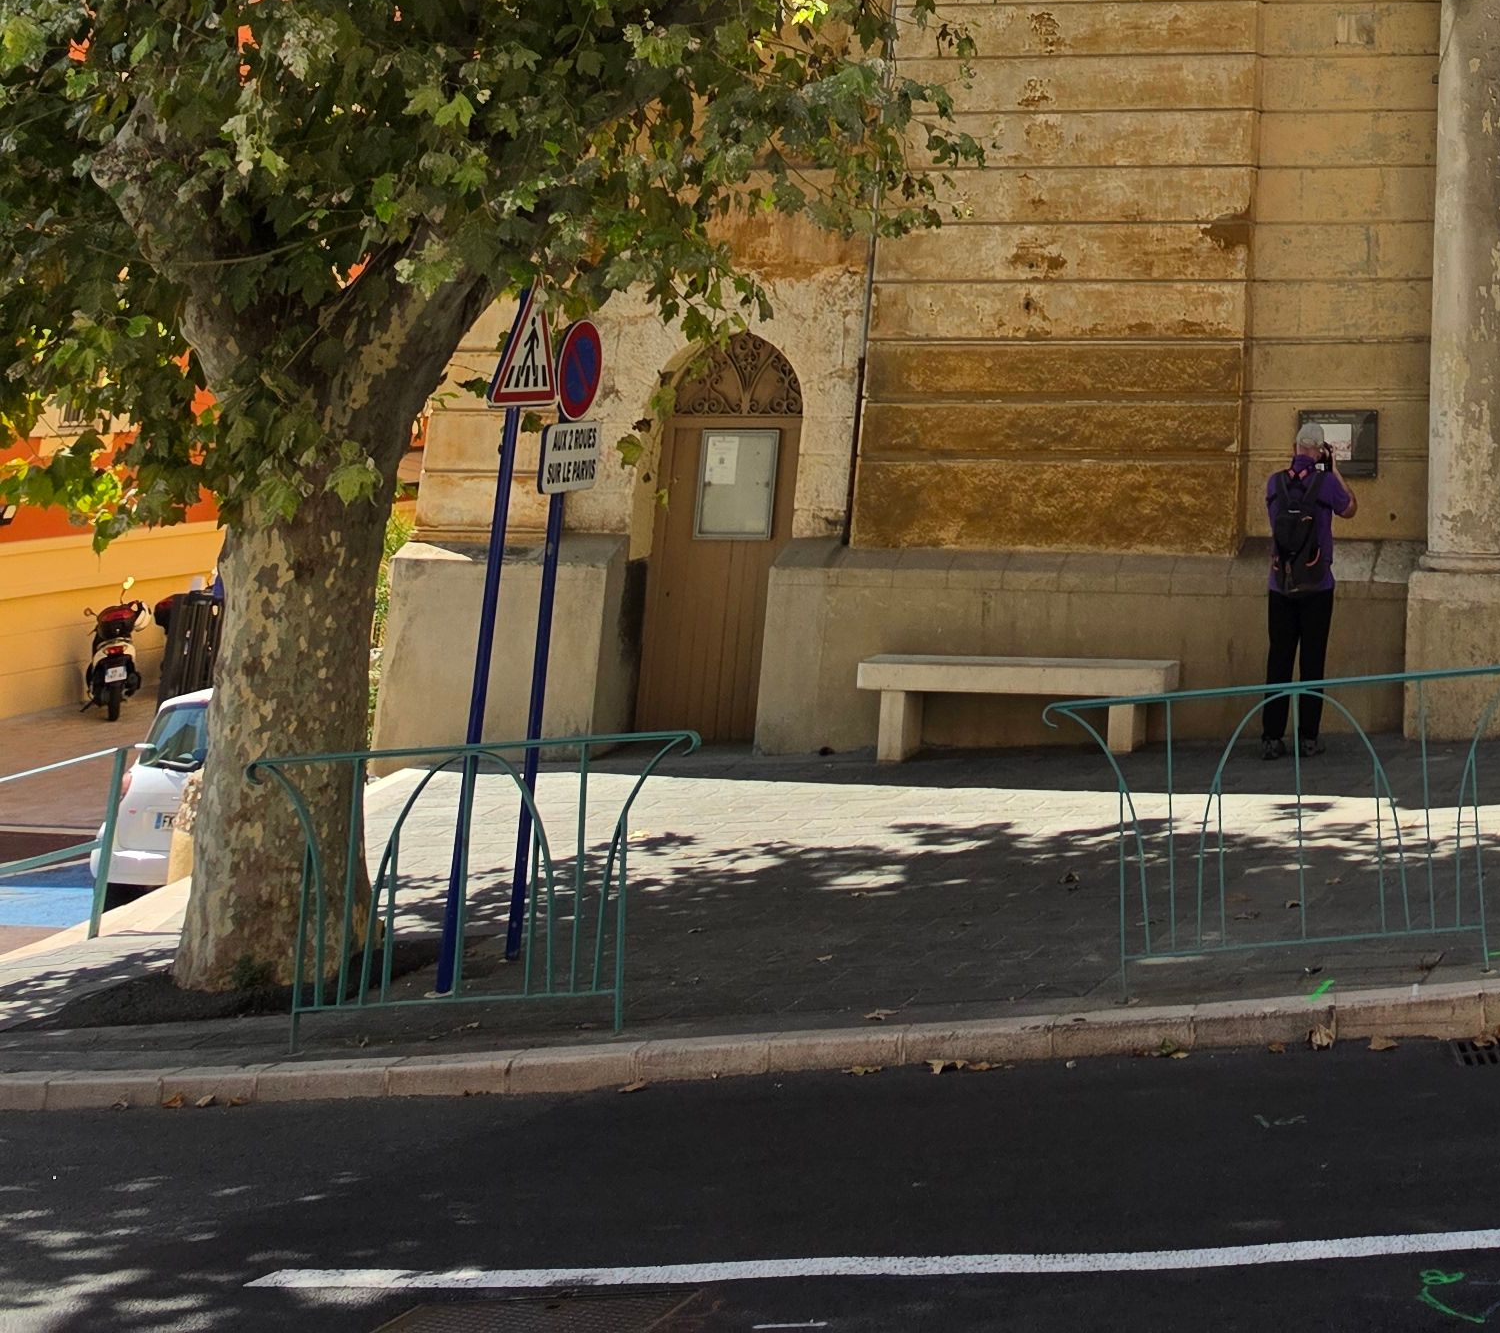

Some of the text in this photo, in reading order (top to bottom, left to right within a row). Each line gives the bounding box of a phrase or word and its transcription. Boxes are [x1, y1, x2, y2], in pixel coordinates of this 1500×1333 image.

[552, 427, 597, 452] AUX 2 ROUES
[547, 458, 596, 484] SUR LE PARVIS
